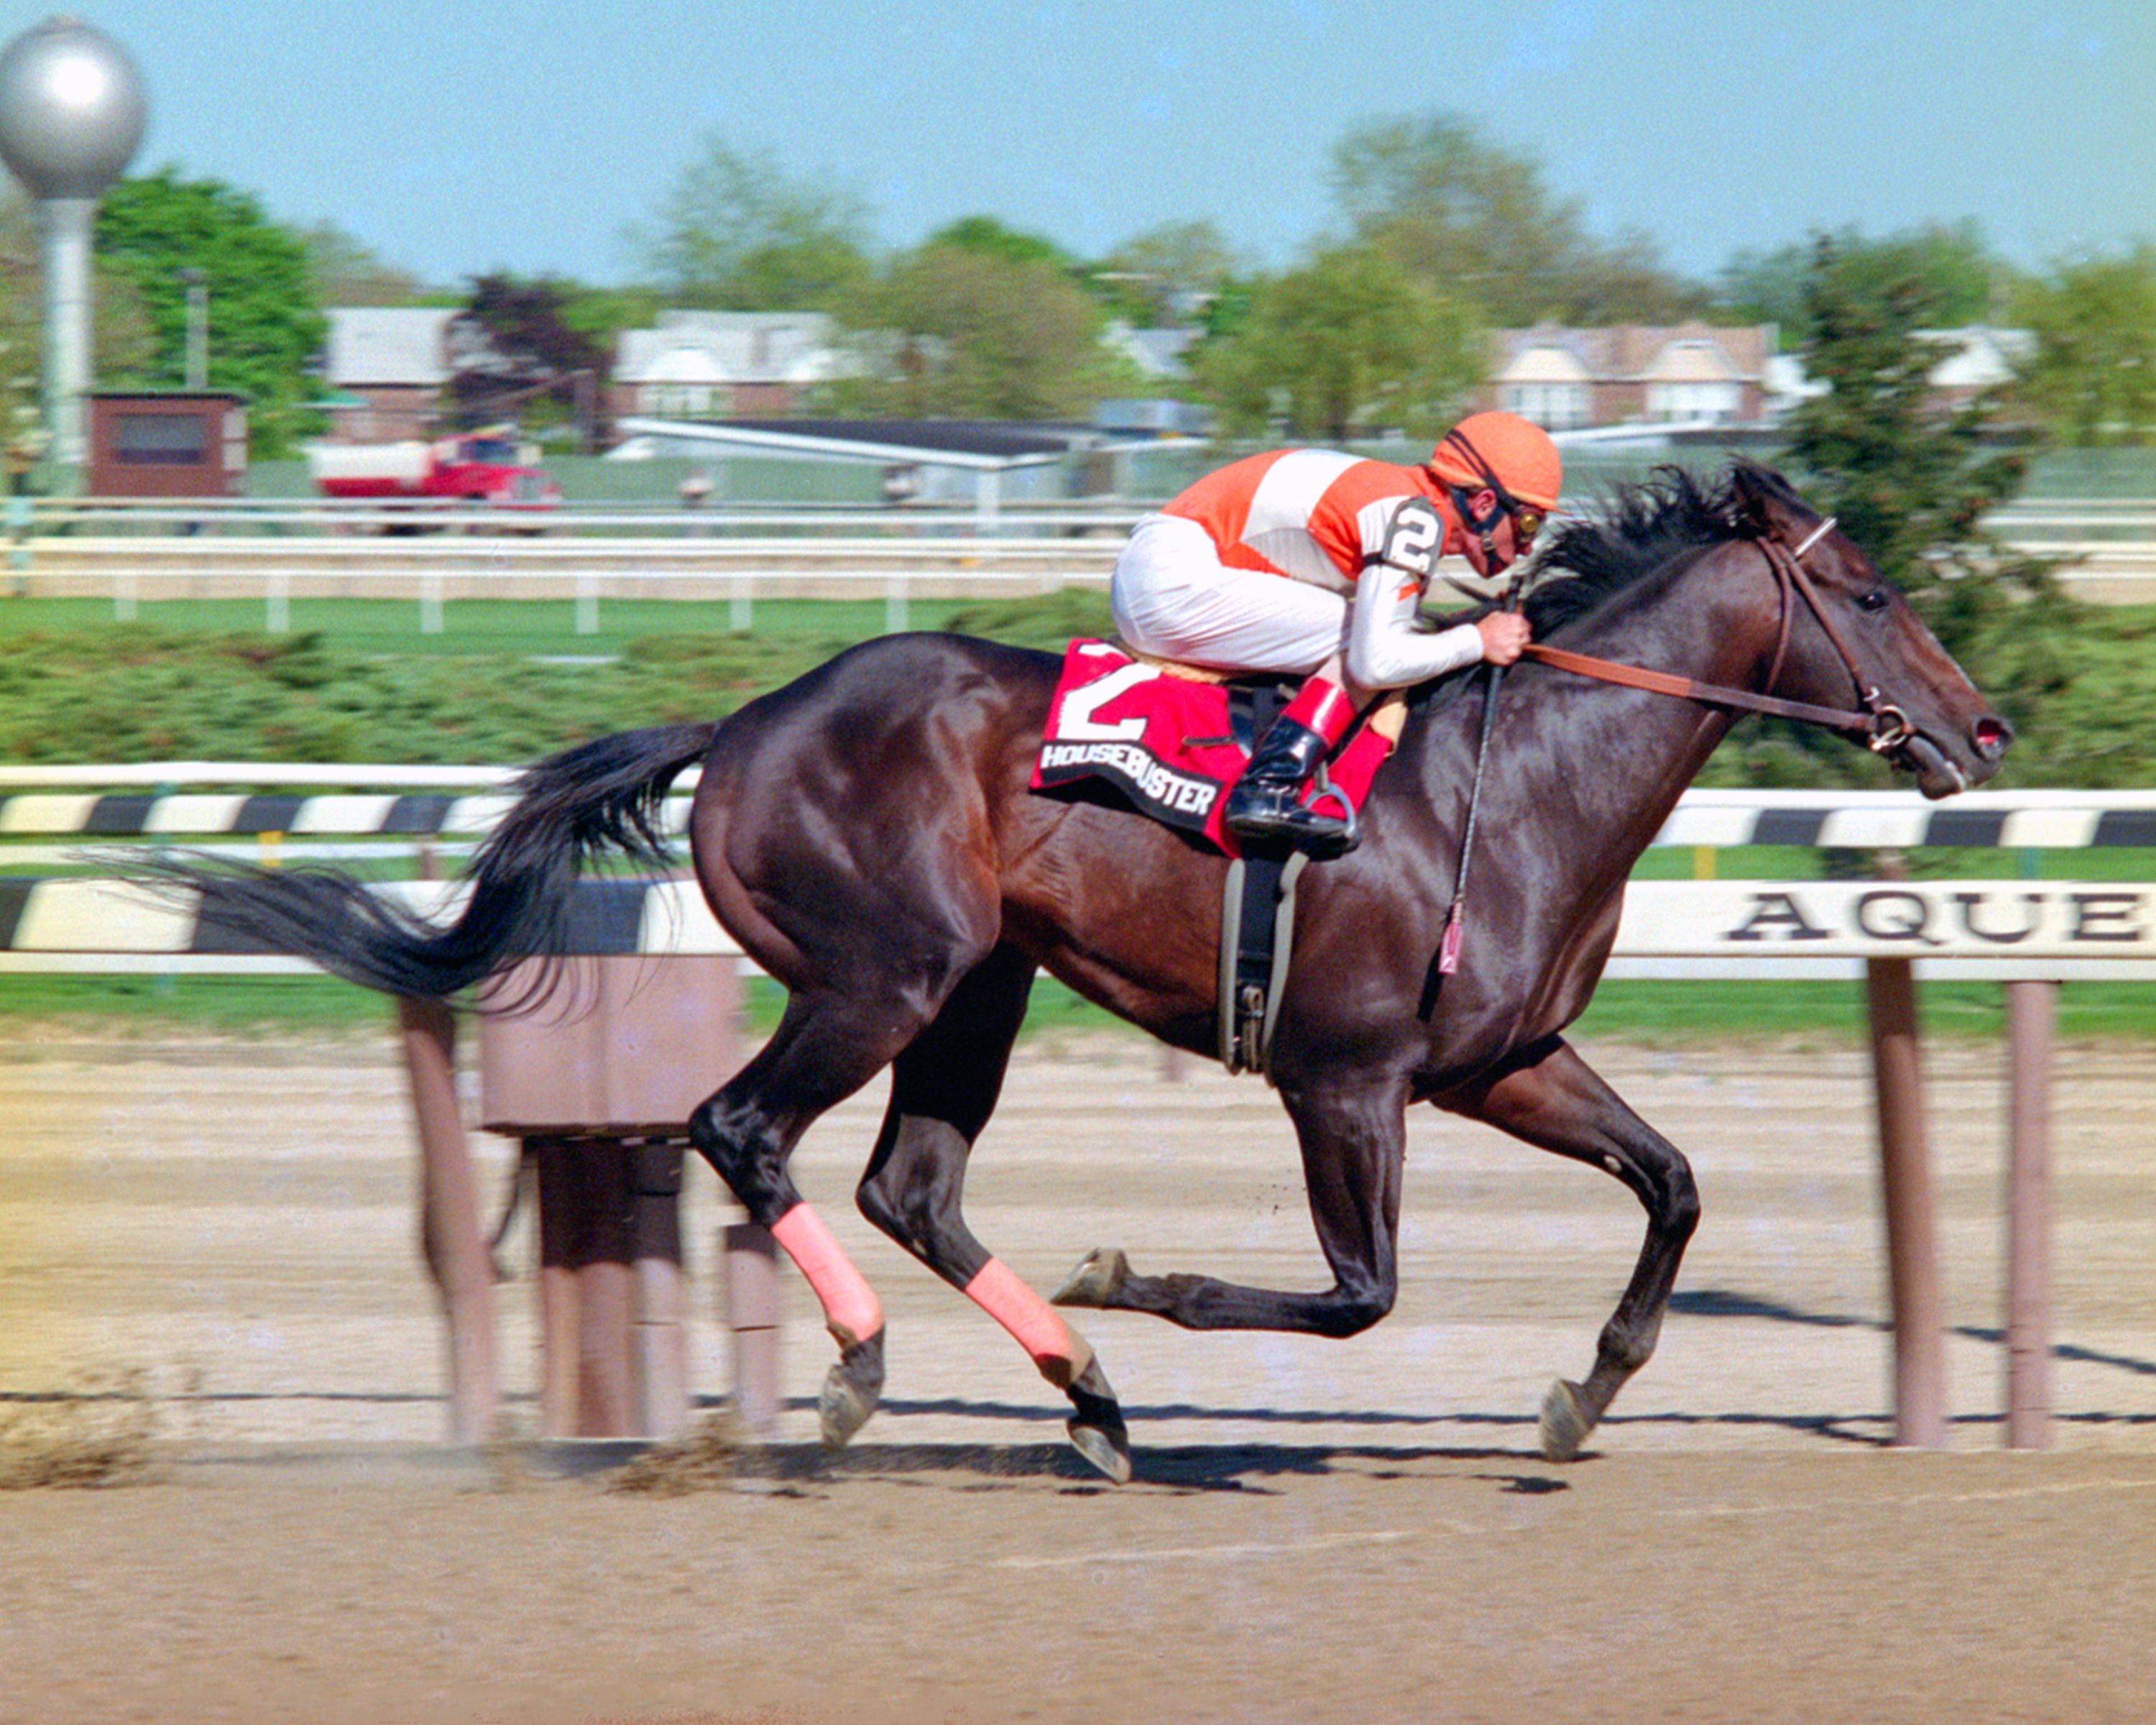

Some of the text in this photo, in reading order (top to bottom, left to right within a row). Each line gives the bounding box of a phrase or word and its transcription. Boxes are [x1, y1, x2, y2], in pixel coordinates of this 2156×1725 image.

[1389, 507, 1438, 572] 2
[1058, 644, 1161, 740] 2
[1041, 745, 1217, 815] HOUSEBUSTER
[1723, 891, 2143, 944] AQUE
